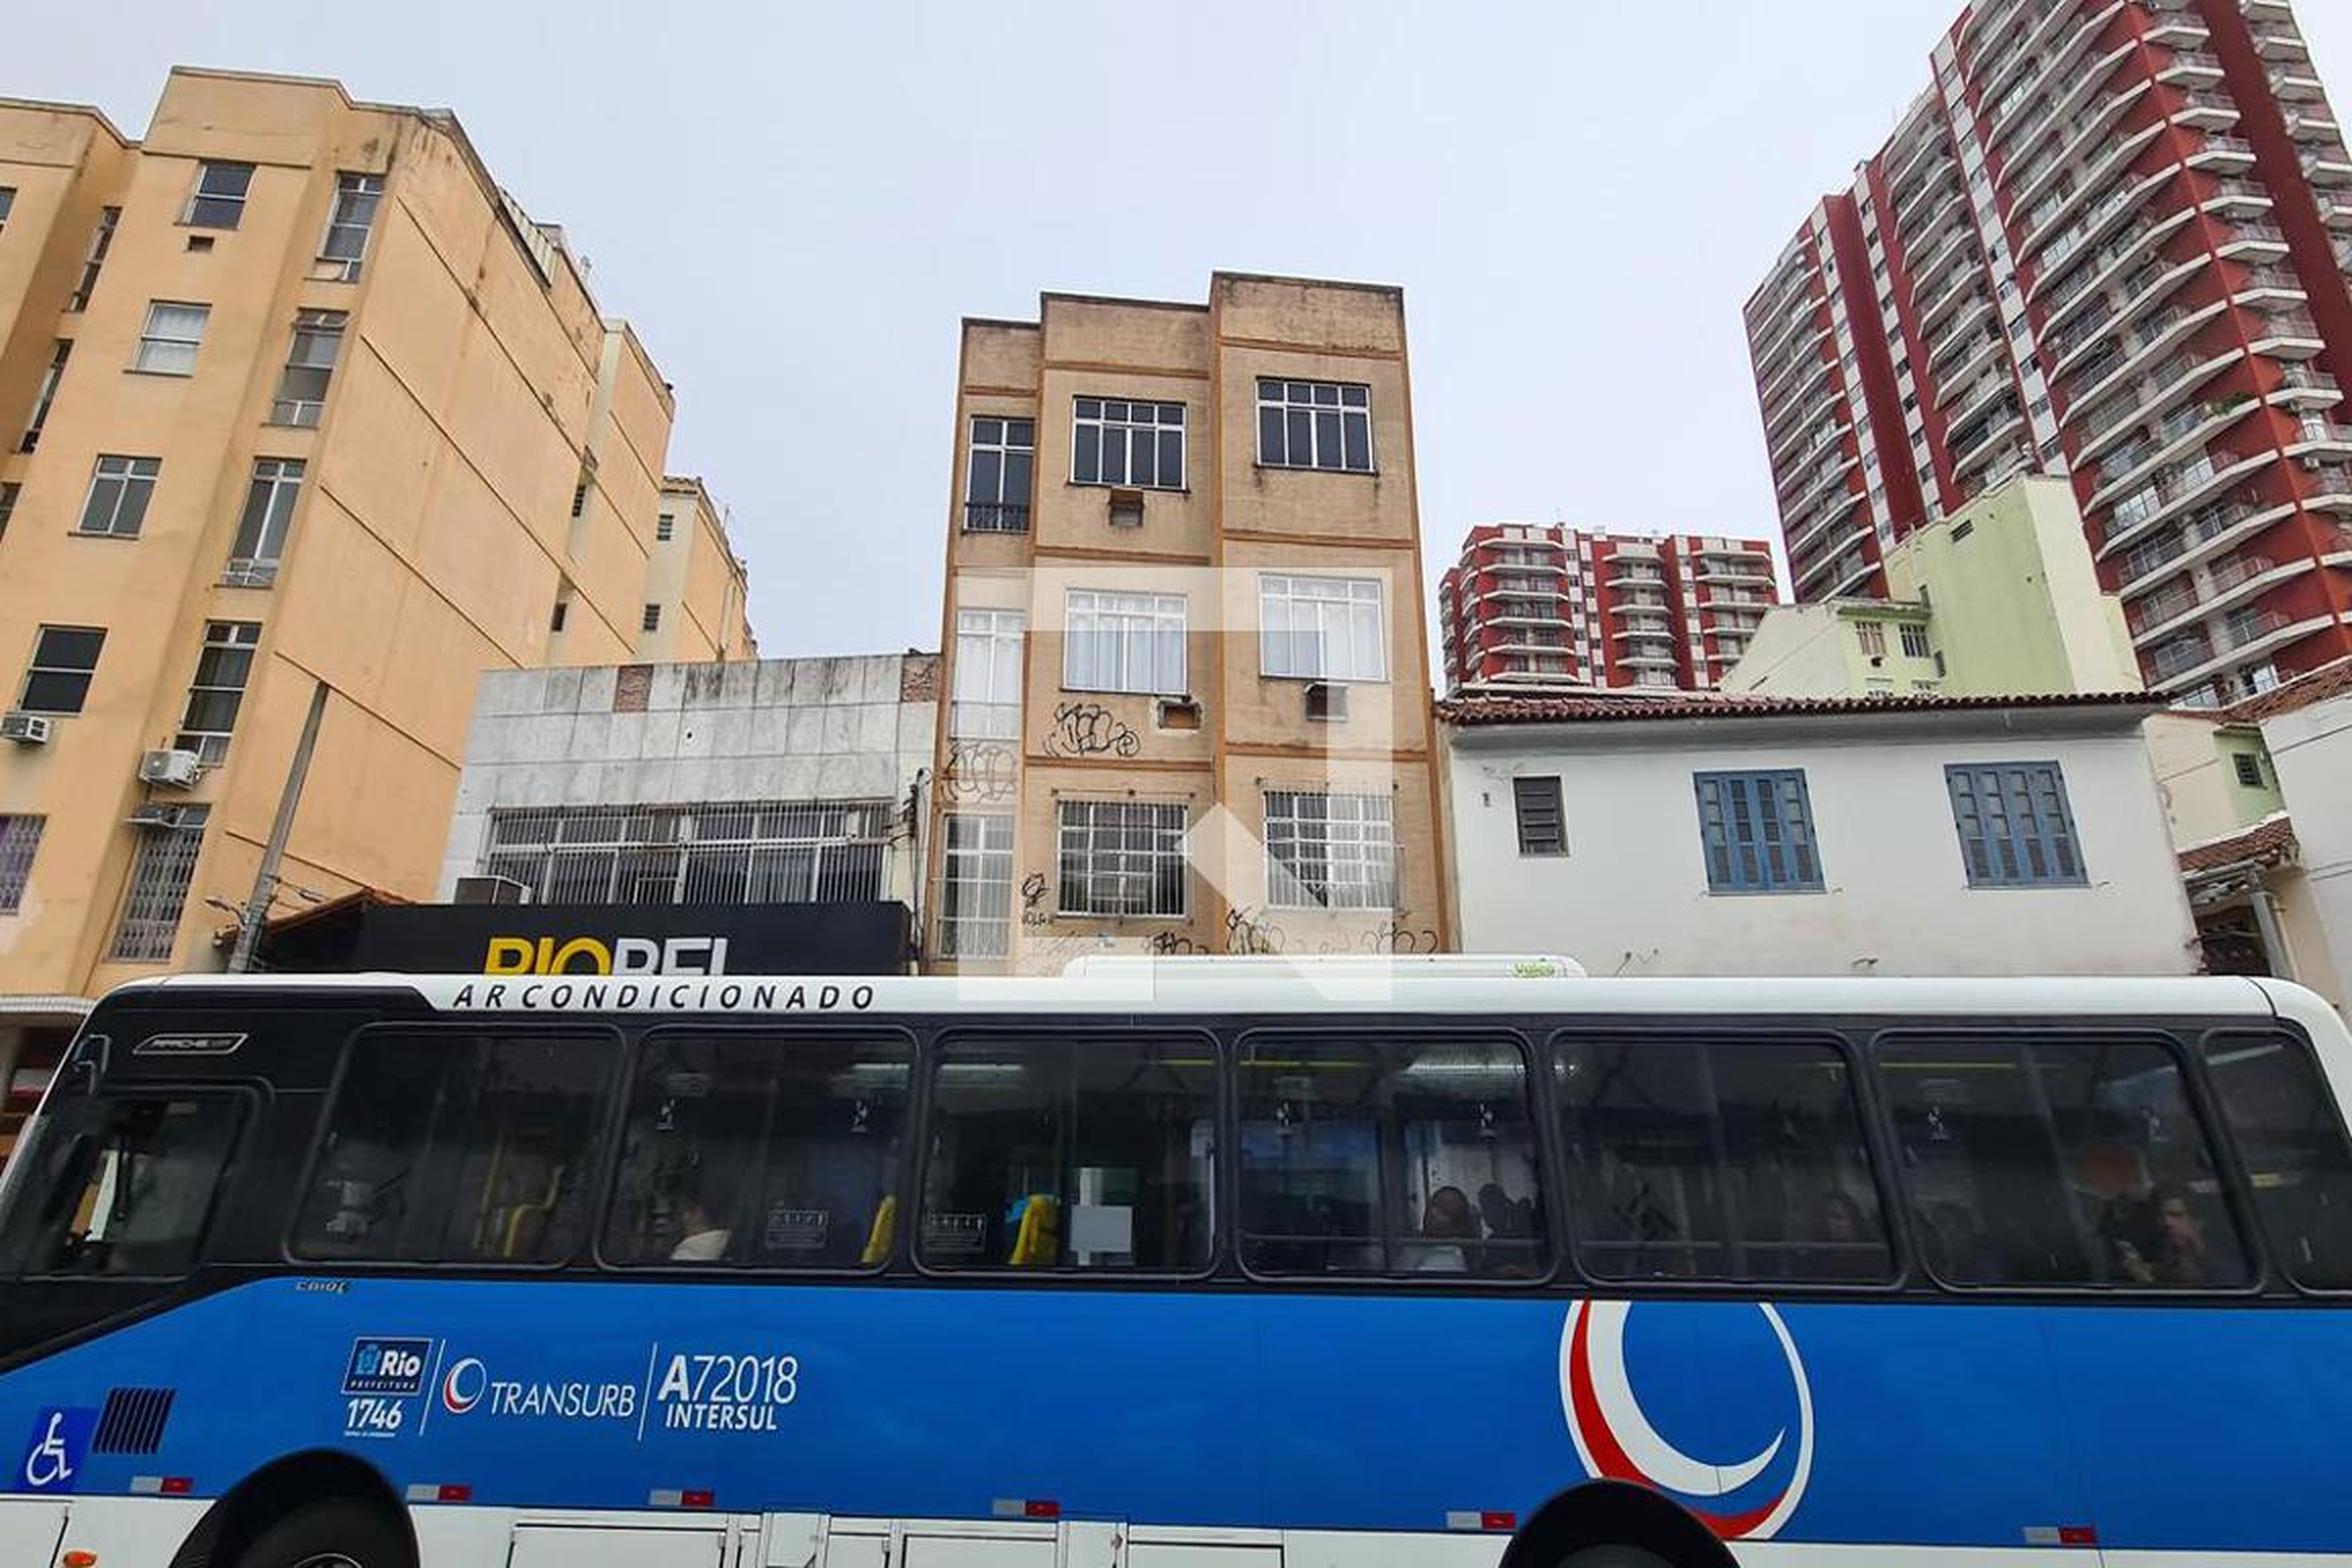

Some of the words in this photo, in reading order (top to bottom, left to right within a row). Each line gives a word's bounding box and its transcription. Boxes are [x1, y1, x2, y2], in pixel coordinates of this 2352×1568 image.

[379, 1349, 421, 1377] Rio
[657, 1354, 798, 1404] A72018
[347, 1398, 402, 1430] 1746
[491, 1382, 636, 1417] TRANSURB
[665, 1404, 778, 1430] INTERSUL
